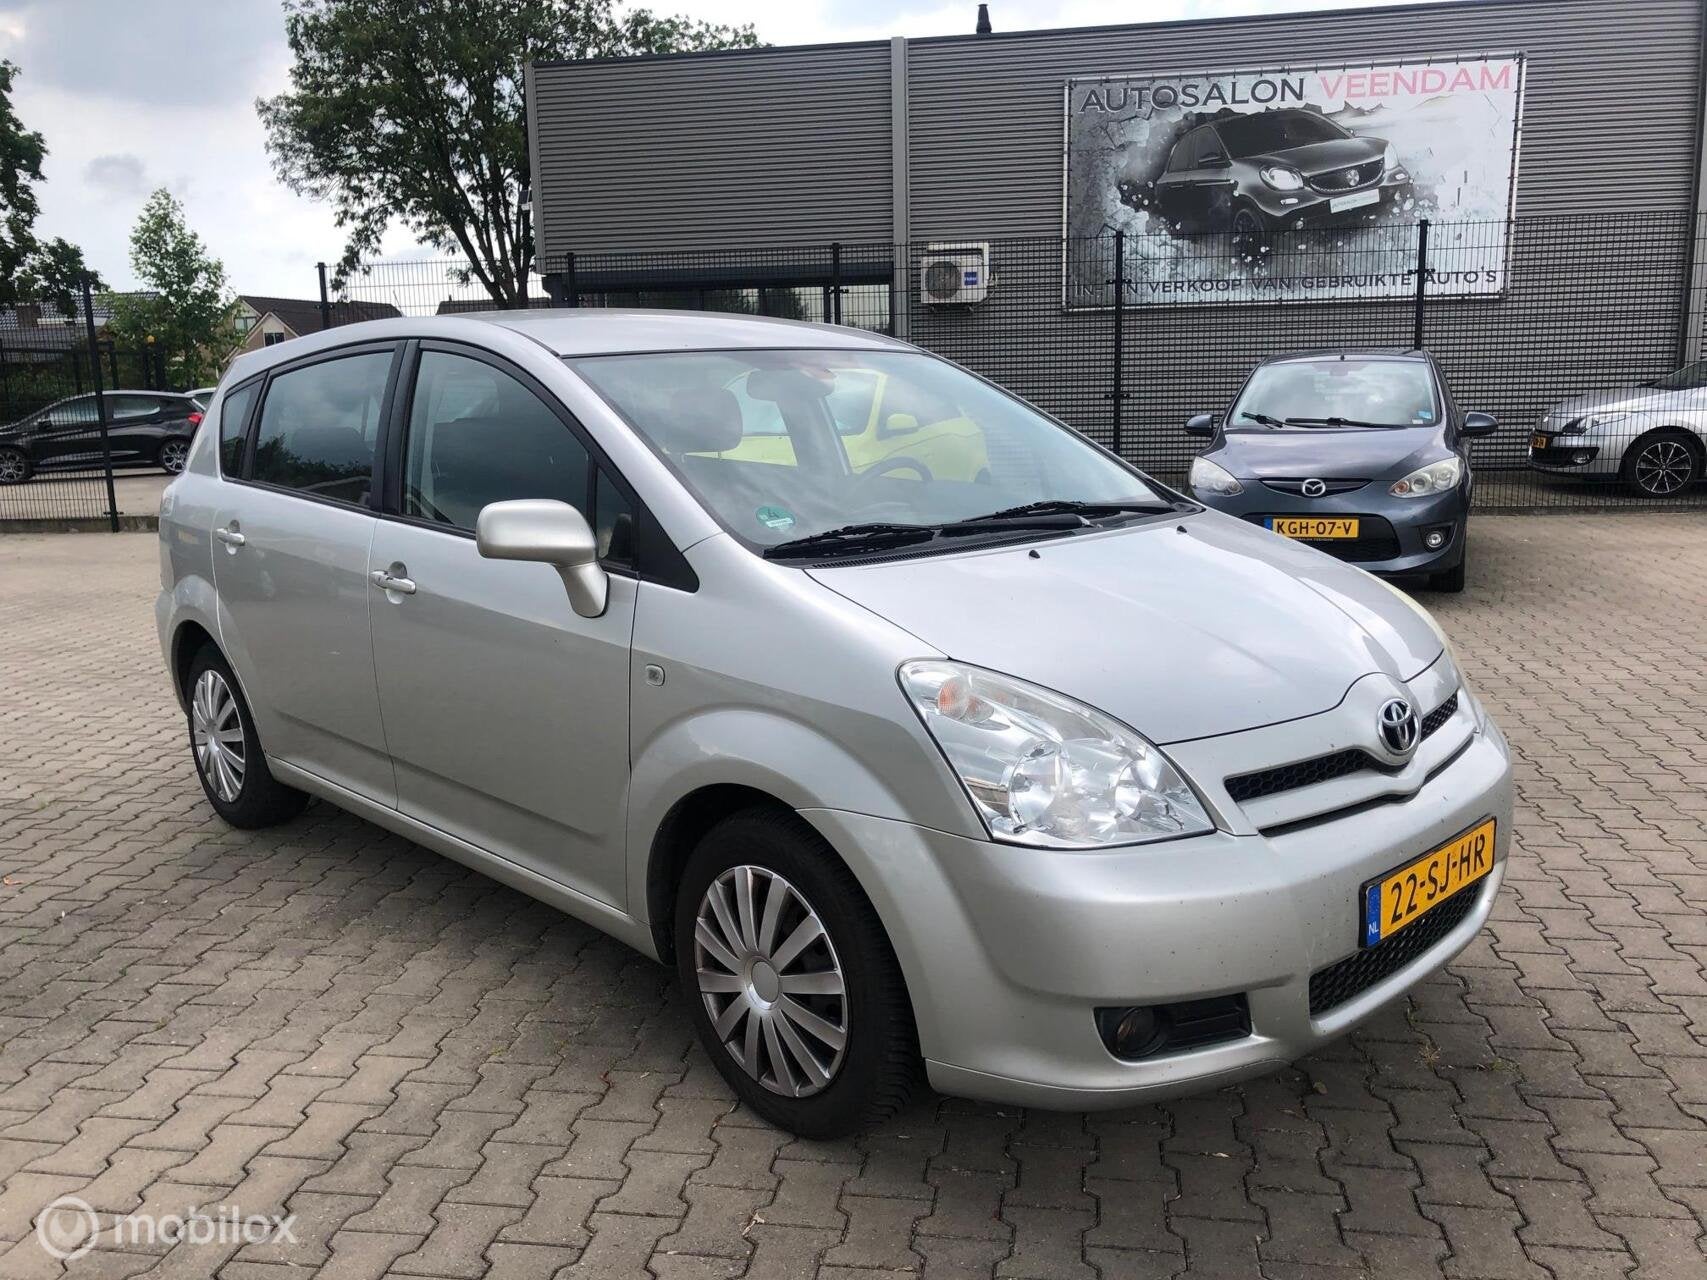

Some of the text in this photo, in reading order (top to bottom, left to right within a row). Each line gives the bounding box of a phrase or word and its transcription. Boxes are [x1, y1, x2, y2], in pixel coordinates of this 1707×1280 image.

[1078, 65, 1511, 114] AUTOSALON VEENDAM
[1149, 279, 1242, 294] VERKOOP
[1250, 277, 1292, 292] VAN
[1301, 273, 1412, 290] GEBRUIKTE
[1423, 267, 1498, 286] AUTO'S
[1277, 521, 1353, 536] KGH-07-V
[1391, 833, 1486, 925] 22-SJ-HR
[1368, 923, 1380, 936] NL
